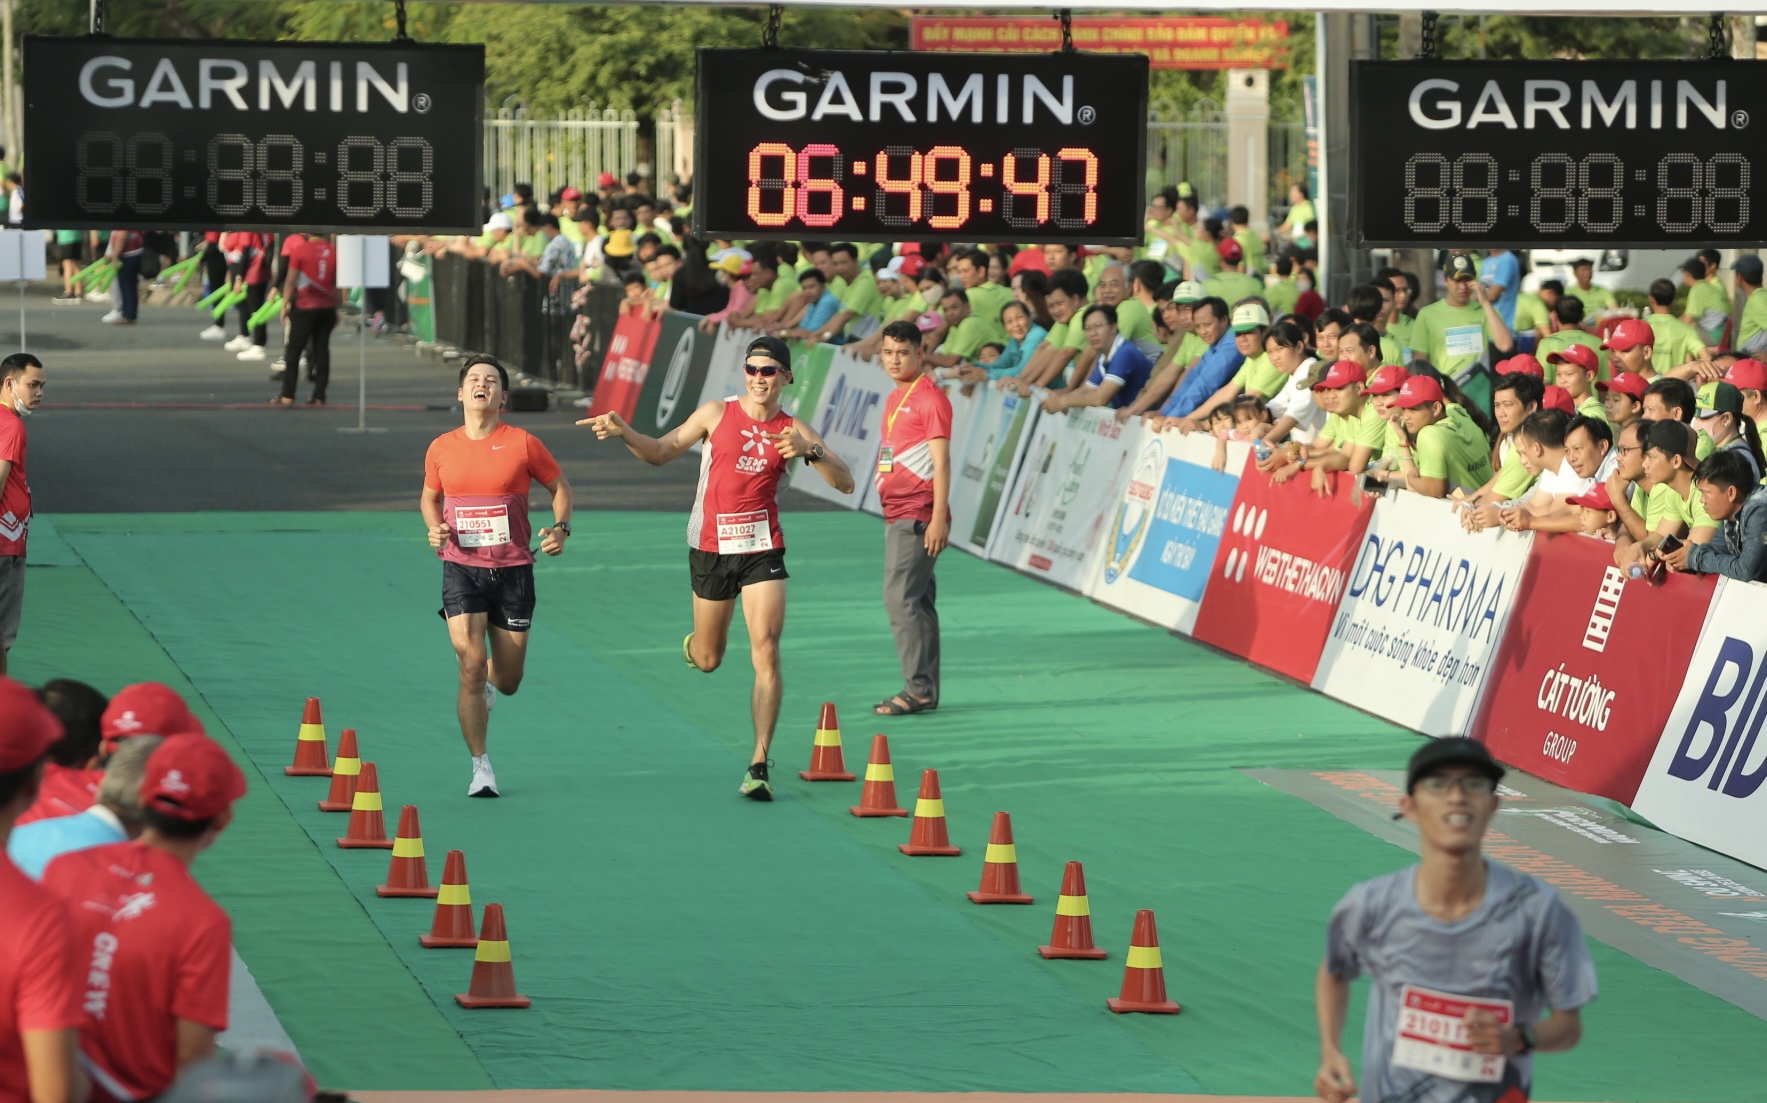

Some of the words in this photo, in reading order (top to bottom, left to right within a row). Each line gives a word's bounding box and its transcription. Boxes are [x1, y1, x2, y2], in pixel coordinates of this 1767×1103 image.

[78, 55, 409, 113] GARMIN
[753, 68, 1074, 125] GARMIN
[1408, 78, 1727, 130] GARMIN
[748, 142, 1098, 229] 06:49:47
[459, 519, 492, 529] 210551
[721, 525, 755, 536] A21027
[1349, 532, 1404, 607] DHG
[1392, 545, 1506, 644] PHARMA
[1345, 619, 1370, 650] một
[1364, 625, 1389, 658] cuộc
[1387, 629, 1414, 669] sống
[1436, 649, 1460, 686] đẹp
[1457, 655, 1480, 688] hơn
[1537, 662, 1570, 714] CÁT
[1562, 673, 1616, 731] TƯỜNG
[1543, 731, 1577, 765] GROUP
